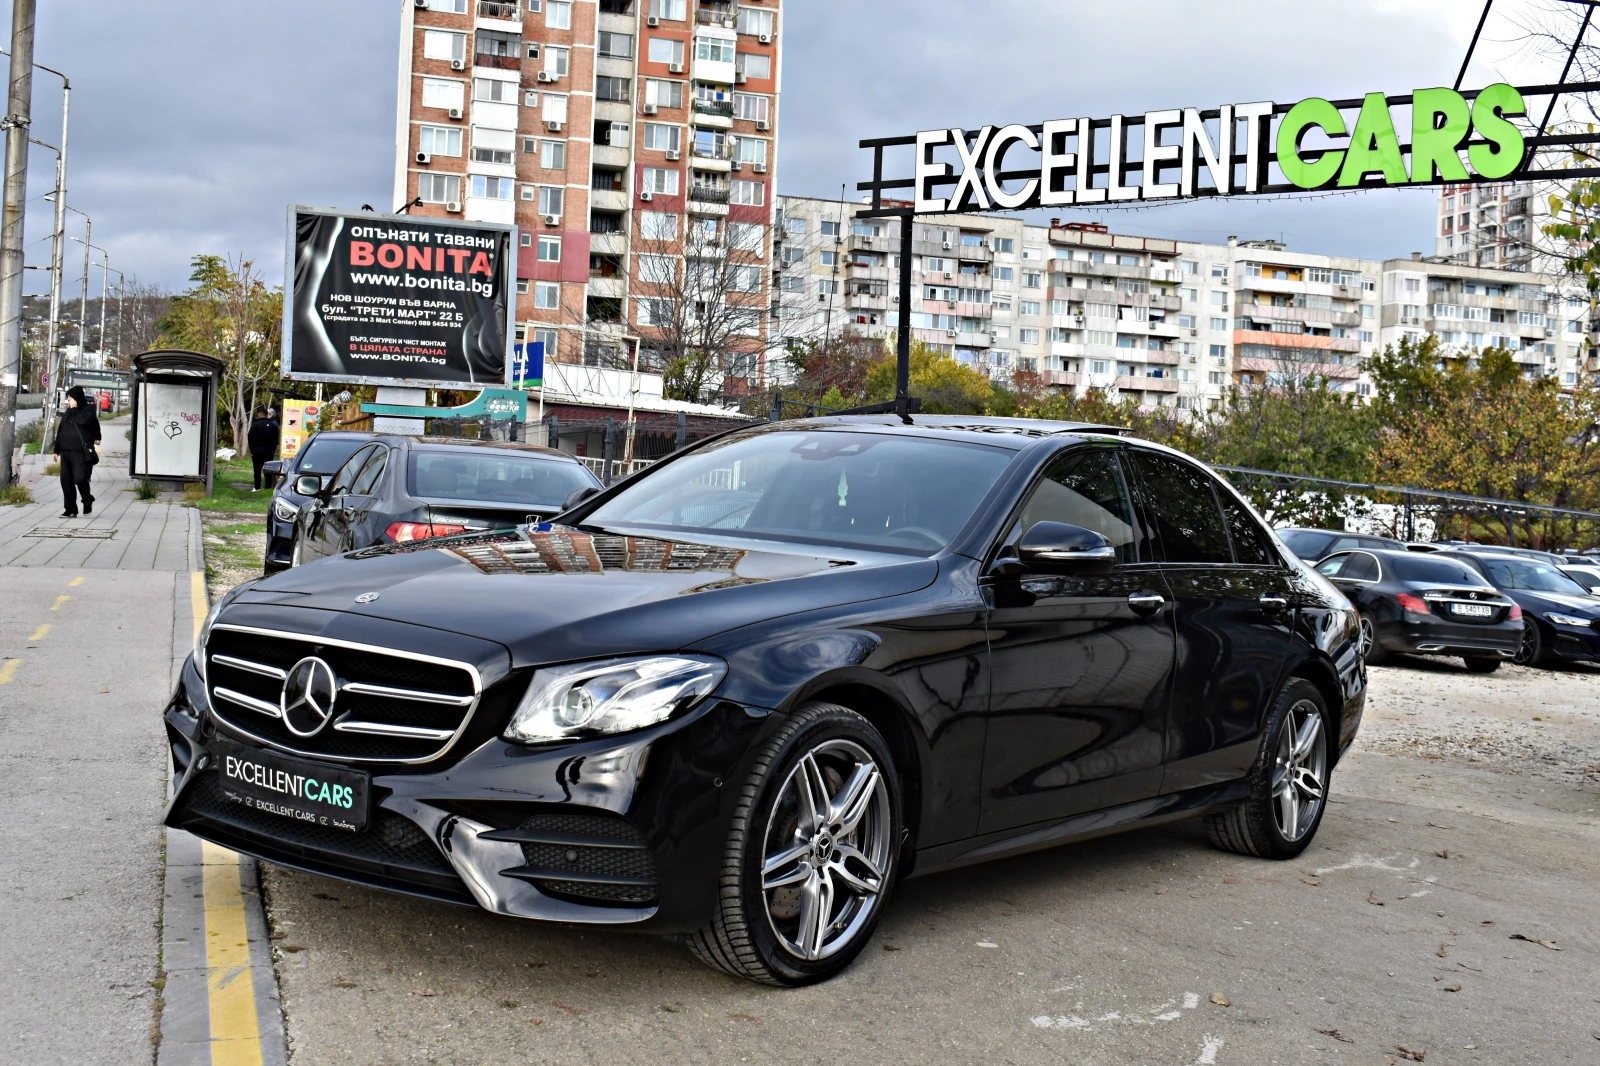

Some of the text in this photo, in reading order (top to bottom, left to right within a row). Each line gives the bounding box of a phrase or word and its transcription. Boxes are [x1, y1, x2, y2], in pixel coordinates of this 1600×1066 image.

[350, 226, 495, 249] опънати тавани
[350, 272, 493, 297] www.bonita.bg
[330, 294, 457, 309] НОВ ШОУРУМ ВЪВ ВАРНА
[321, 304, 347, 315] бул.
[439, 311, 453, 320] 22
[455, 312, 464, 321] Б
[392, 318, 418, 327] Center)
[432, 320, 448, 328] 5454
[349, 343, 447, 356] В ЦЯЛАТА СТРАНА!
[403, 338, 420, 346] ЧИСТ
[350, 353, 447, 365] www.BONITA.bg
[256, 800, 316, 823] EXCELLENT CARS
